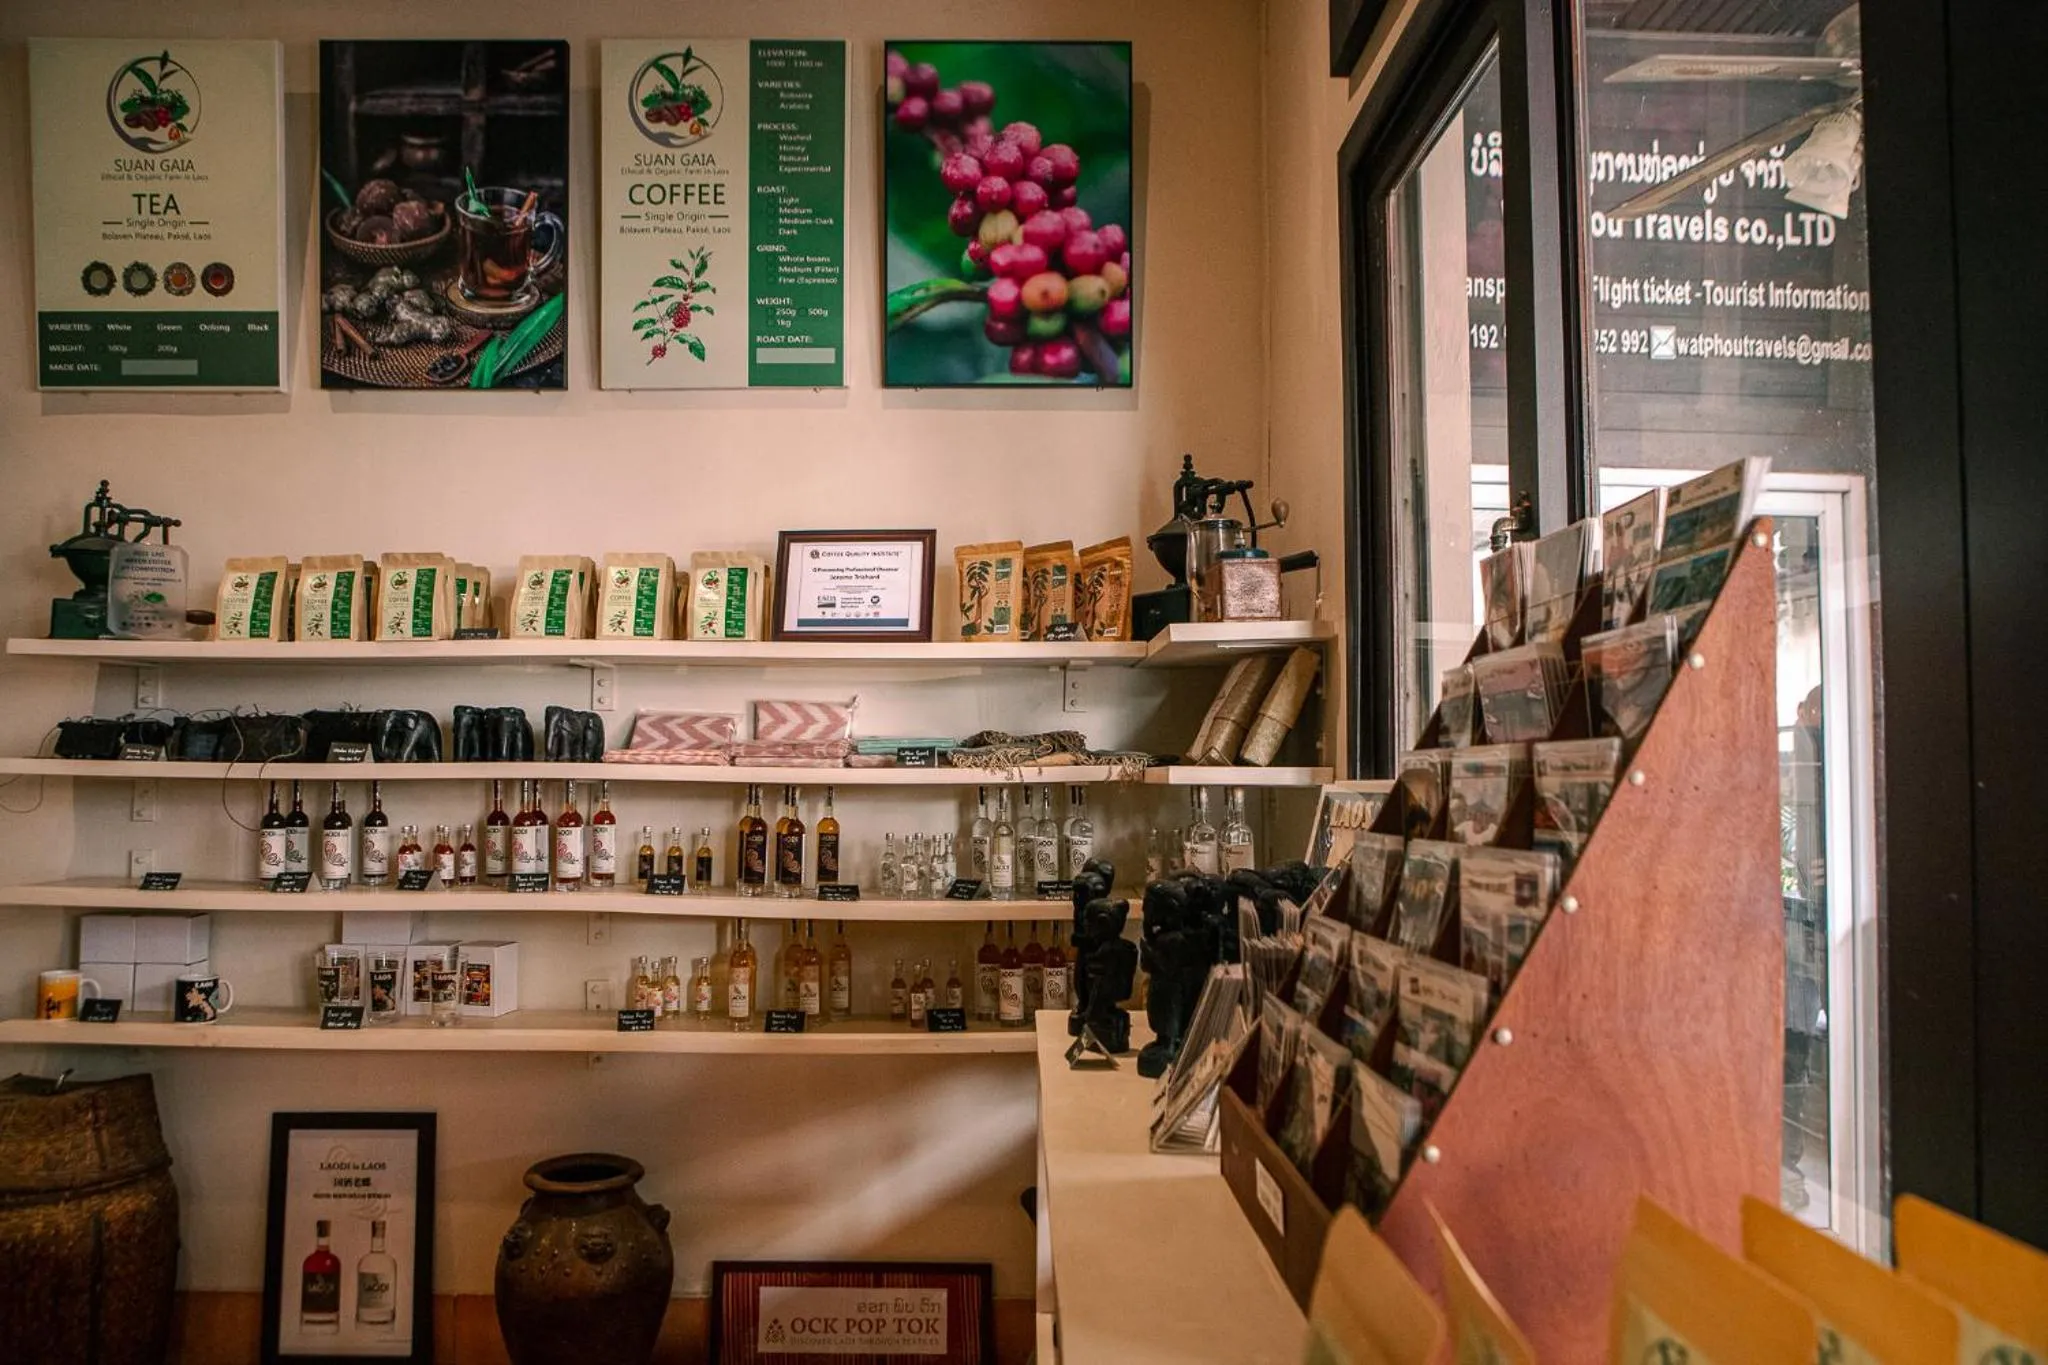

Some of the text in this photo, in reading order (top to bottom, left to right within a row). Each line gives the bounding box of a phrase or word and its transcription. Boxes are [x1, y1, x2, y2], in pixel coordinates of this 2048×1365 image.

[757, 122, 798, 130] PROCESS:
[634, 153, 716, 166] SUAN GAIA
[778, 154, 809, 162] Natural
[114, 158, 196, 172] SUAN GAIA
[778, 165, 831, 174] Experimental
[756, 186, 787, 194] ROAST:
[628, 184, 726, 206] COFFEE
[132, 193, 181, 216] TEA
[778, 196, 800, 205] Light
[644, 211, 706, 222] Single Origin
[126, 218, 187, 229] Single Origin
[1590, 210, 1624, 239] ou
[712, 226, 731, 234] Laos
[778, 228, 798, 236] Dark
[193, 232, 212, 241] Laos
[756, 244, 787, 252] GRIND:
[778, 266, 812, 274] Medium
[778, 276, 838, 286] Fine (Espresso)
[1466, 276, 1506, 305] ansp
[1642, 276, 1692, 306] ticket
[1770, 280, 1870, 312] Information
[756, 298, 792, 306] WEIGHT:
[776, 308, 829, 318] 250g 500g
[106, 322, 132, 332] White
[156, 322, 182, 332] Green
[198, 322, 231, 334] Oolong
[248, 322, 269, 332] Black
[776, 319, 792, 328] 1kg
[756, 336, 786, 344] ROAST
[1470, 323, 1499, 349] 192
[1620, 328, 1650, 354] 992
[1677, 330, 1872, 365] watphoutravels@gmail.co
[48, 363, 74, 372] MADE
[319, 1162, 350, 1170] LAODI
[790, 1317, 940, 1334] OCK POP TOK
[790, 1337, 832, 1346] DISCOVER
[858, 1337, 900, 1346] THROUGH
